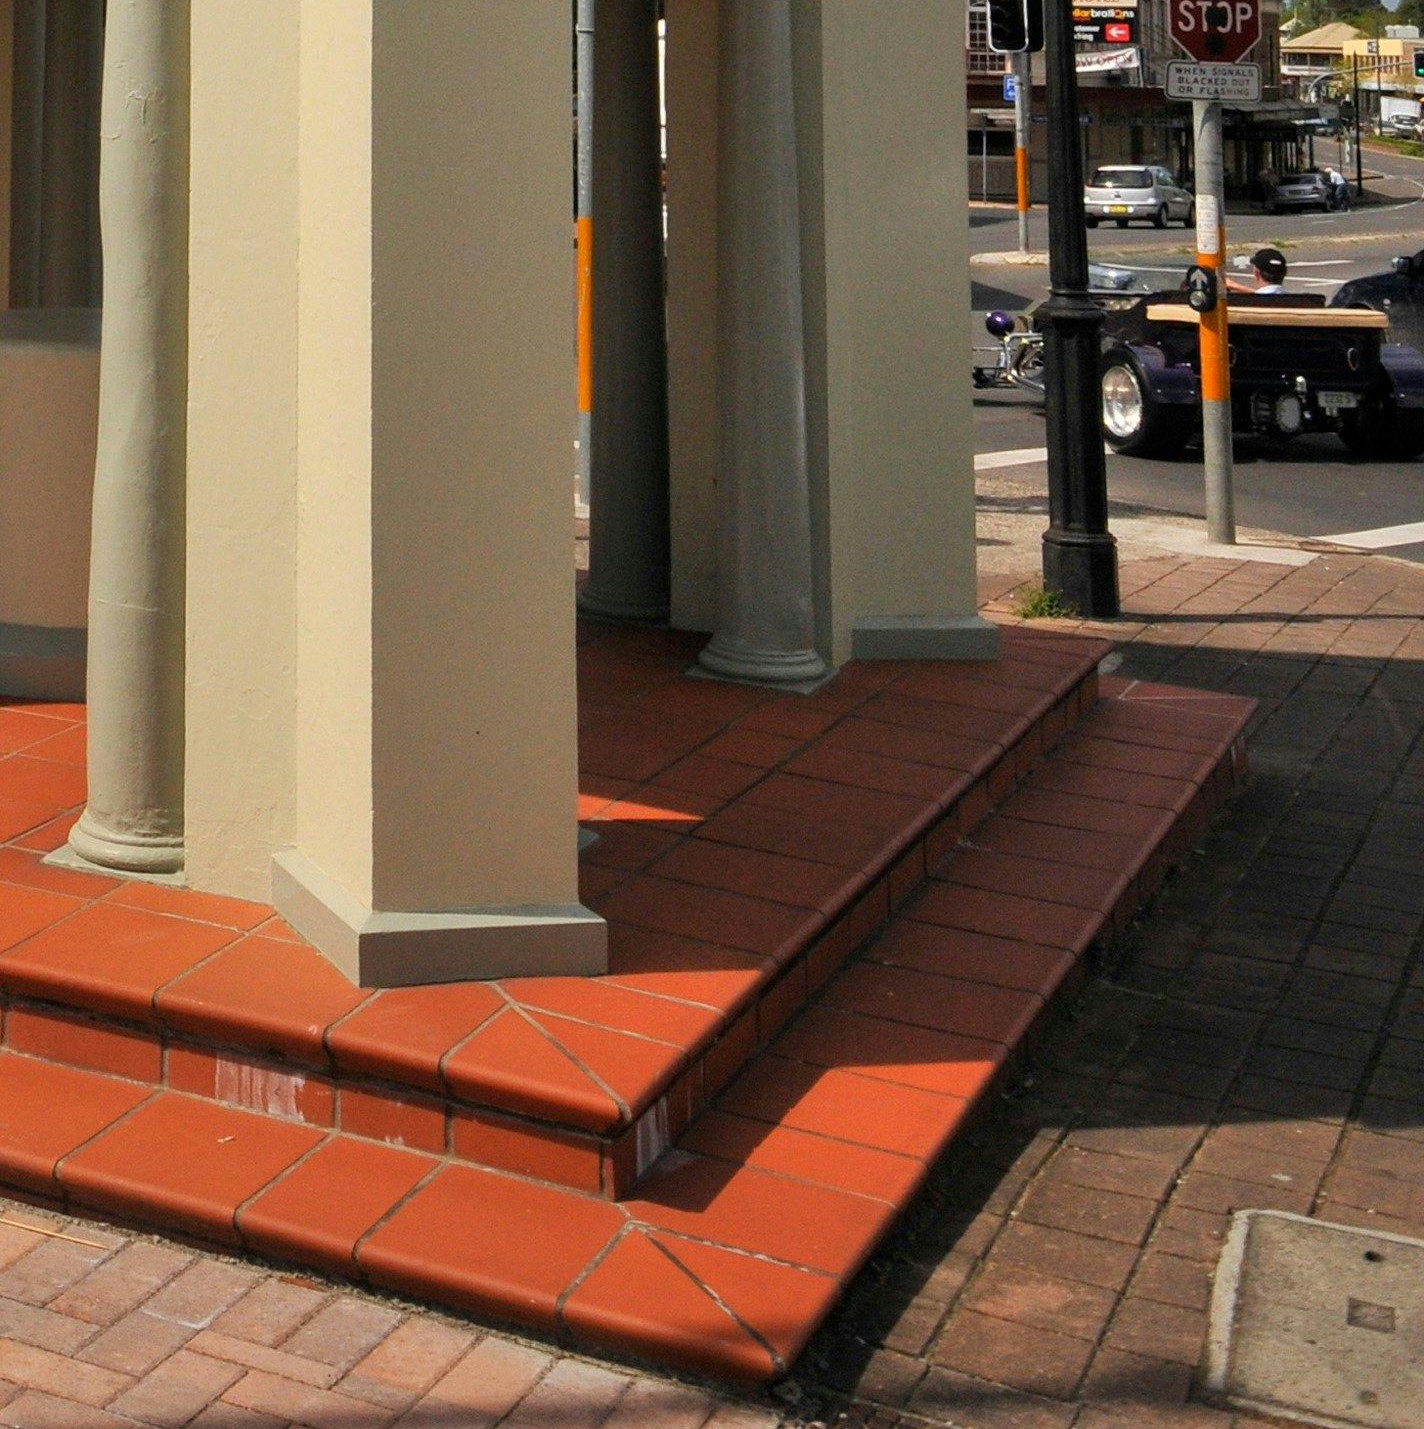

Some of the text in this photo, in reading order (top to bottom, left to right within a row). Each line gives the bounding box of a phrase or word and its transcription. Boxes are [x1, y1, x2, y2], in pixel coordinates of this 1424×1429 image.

[1177, 0, 1253, 34] STOP
[1175, 66, 1255, 77] WHEN SIGNALS
[1177, 76, 1250, 87] BLACKED OUT
[1178, 86, 1250, 97] OR FLASHING
